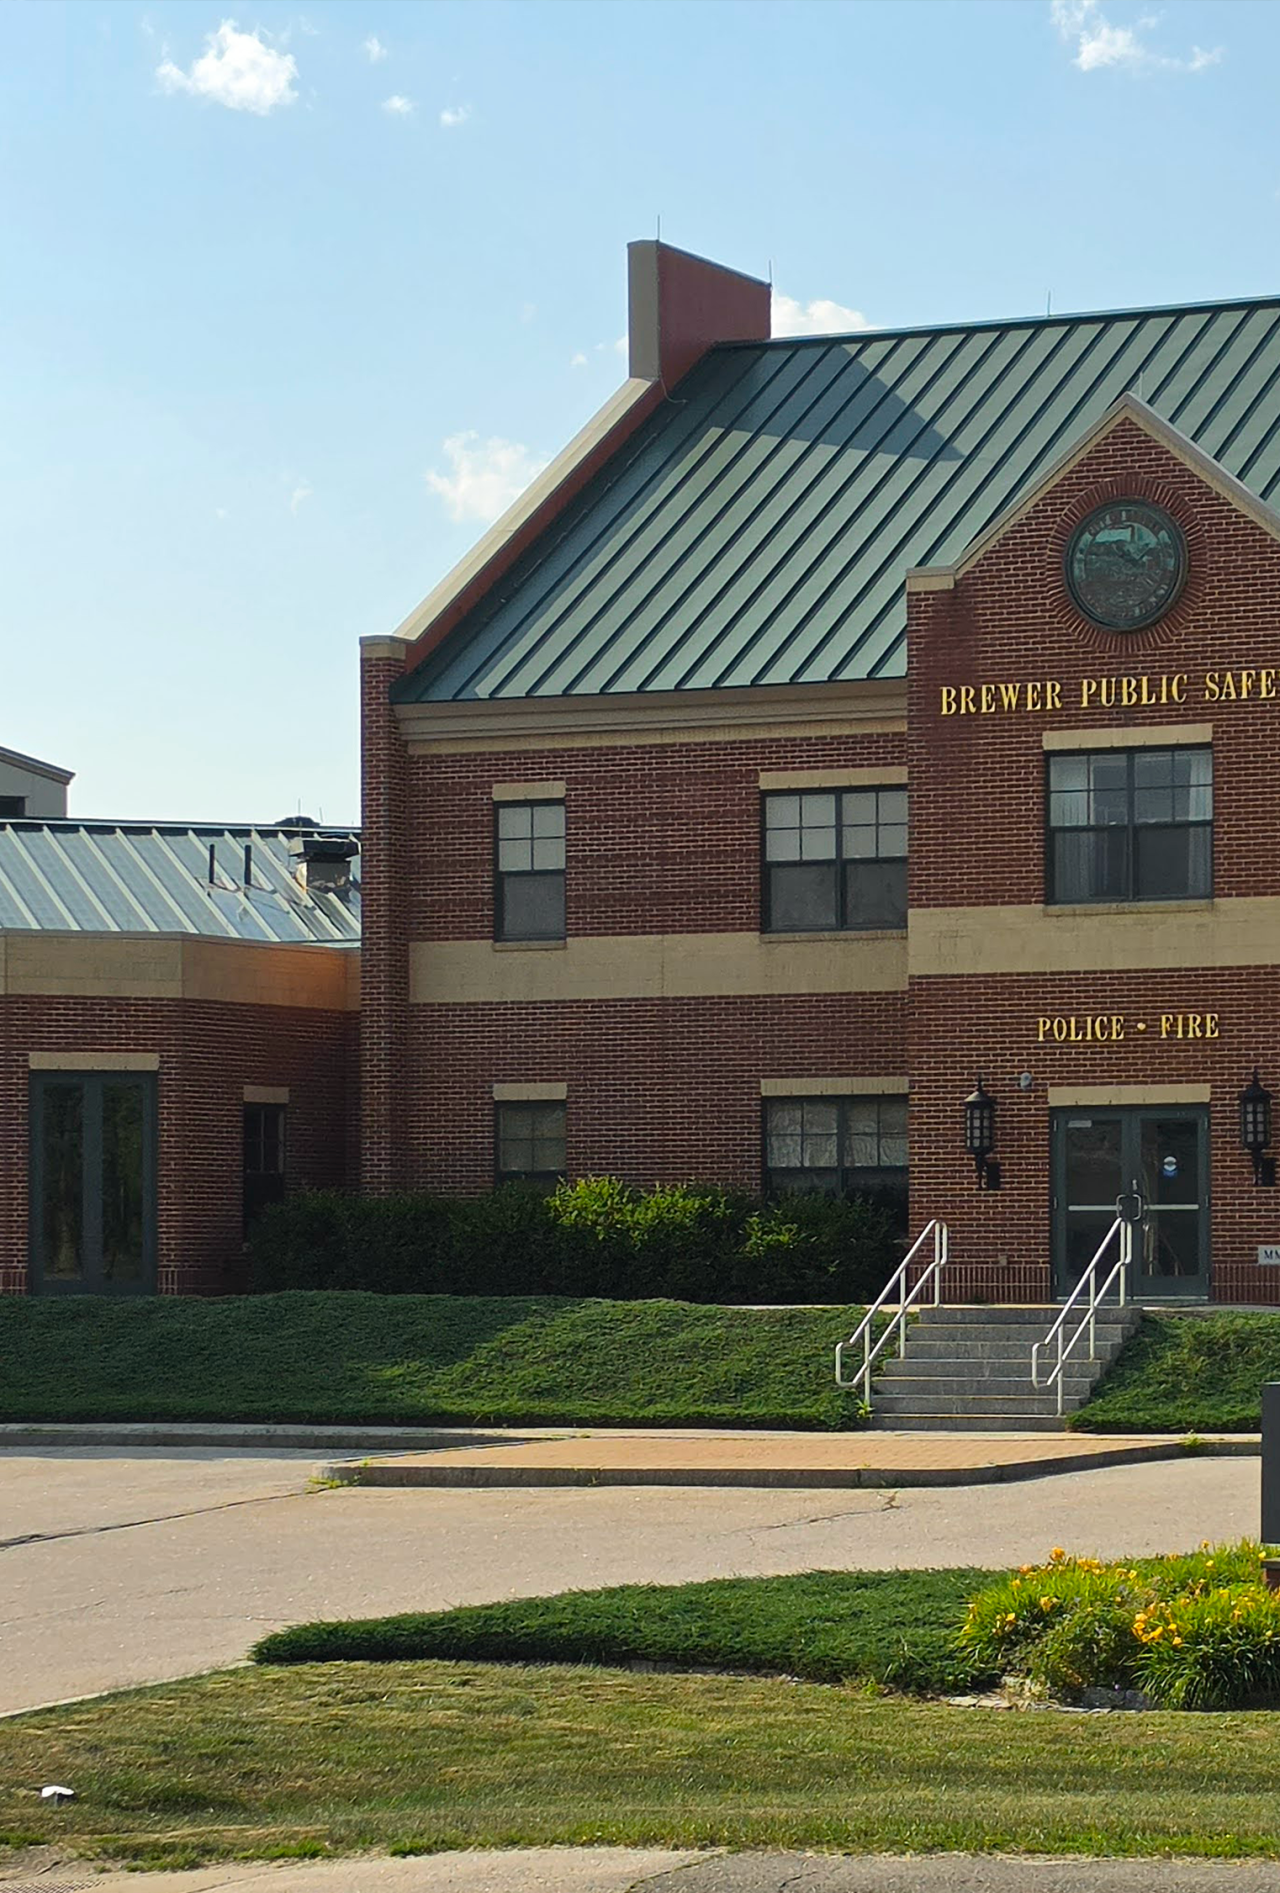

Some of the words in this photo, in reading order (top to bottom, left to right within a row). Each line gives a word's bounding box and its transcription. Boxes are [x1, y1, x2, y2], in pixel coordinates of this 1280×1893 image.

[940, 681, 1062, 715] BREWER
[1081, 673, 1188, 707] PUBLIC
[1037, 1016, 1125, 1041] POLICE
[1161, 1013, 1219, 1038] FIRE
